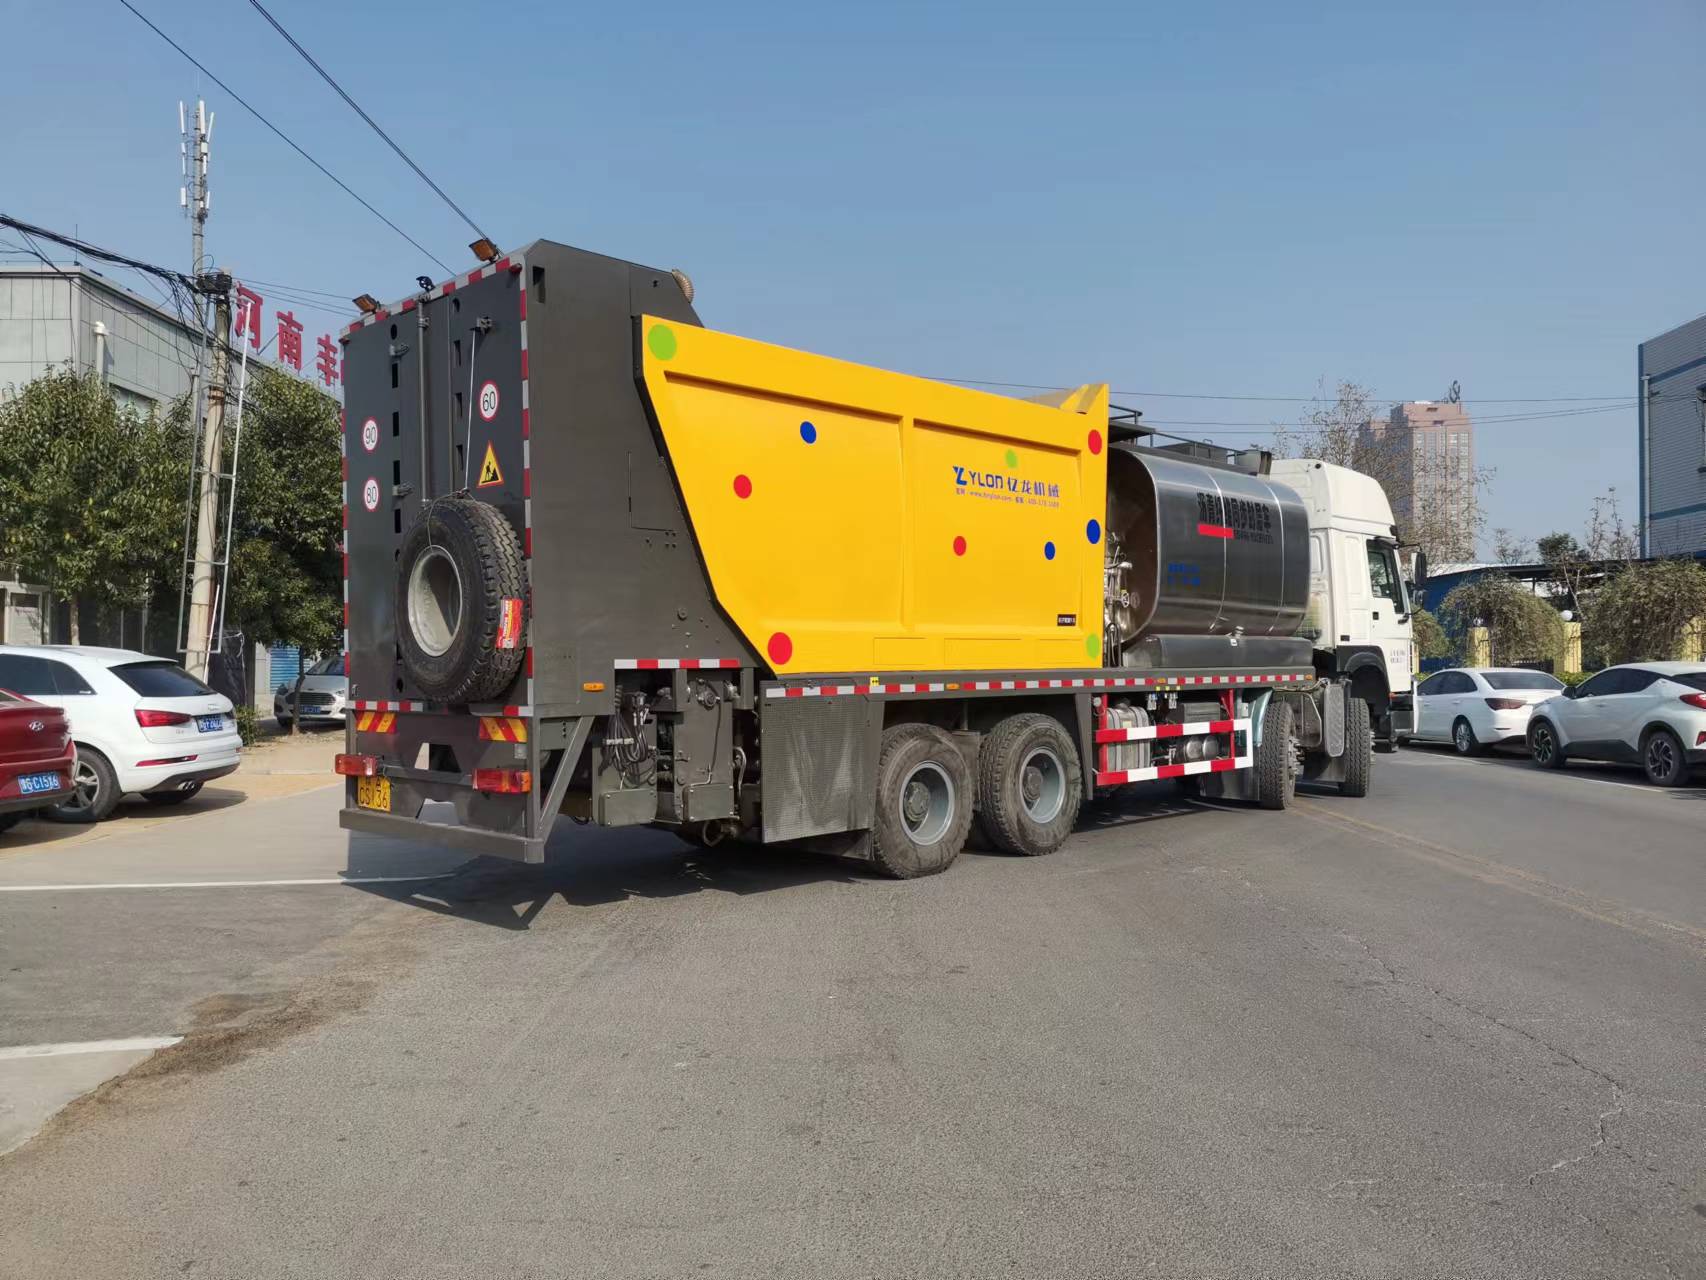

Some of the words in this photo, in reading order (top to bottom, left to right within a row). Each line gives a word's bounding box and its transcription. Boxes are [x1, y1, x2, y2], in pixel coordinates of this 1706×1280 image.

[482, 391, 496, 412] 60
[365, 425, 377, 444] 90
[366, 485, 377, 504] 80
[1007, 477, 1060, 498] 亿龙机械
